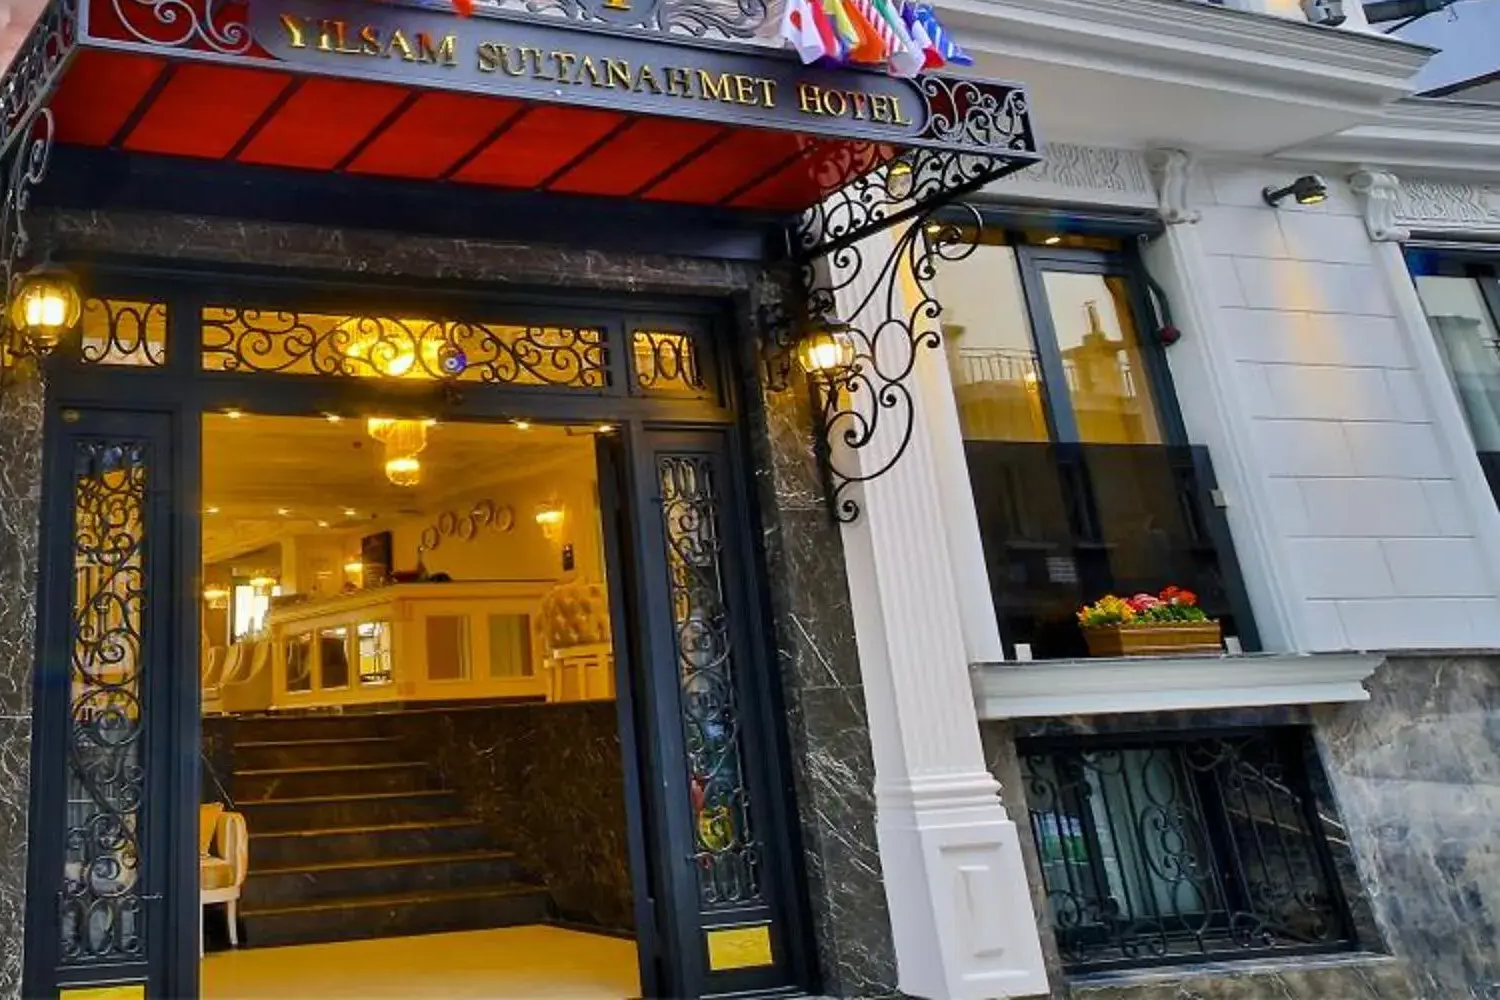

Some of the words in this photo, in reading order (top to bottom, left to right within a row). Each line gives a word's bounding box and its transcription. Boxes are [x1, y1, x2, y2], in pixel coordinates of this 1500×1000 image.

[279, 12, 459, 67] YILSAM
[476, 40, 777, 108] SULTANAHMET
[797, 82, 913, 126] HOTEL
